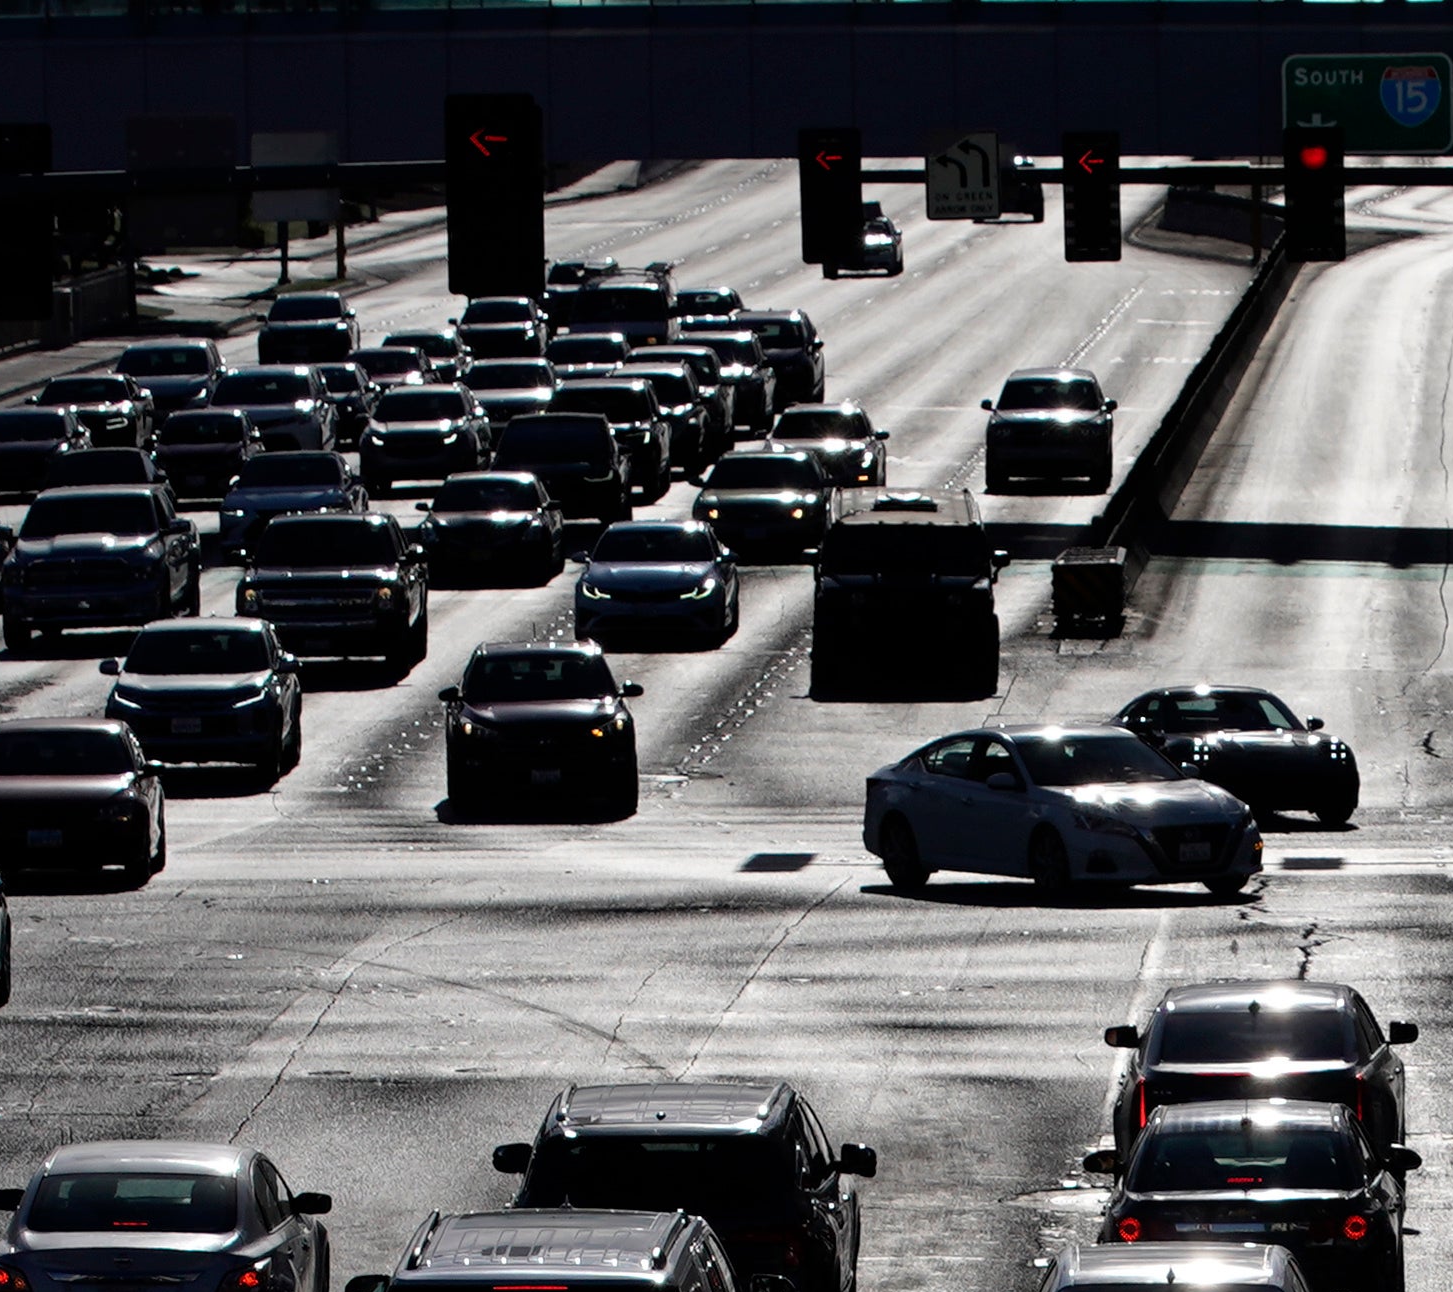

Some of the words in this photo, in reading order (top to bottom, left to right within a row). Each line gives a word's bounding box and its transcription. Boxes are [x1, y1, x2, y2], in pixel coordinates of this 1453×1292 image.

[1294, 67, 1364, 86] SOUTH
[1397, 81, 1429, 114] 15
[956, 191, 993, 201] GREEN
